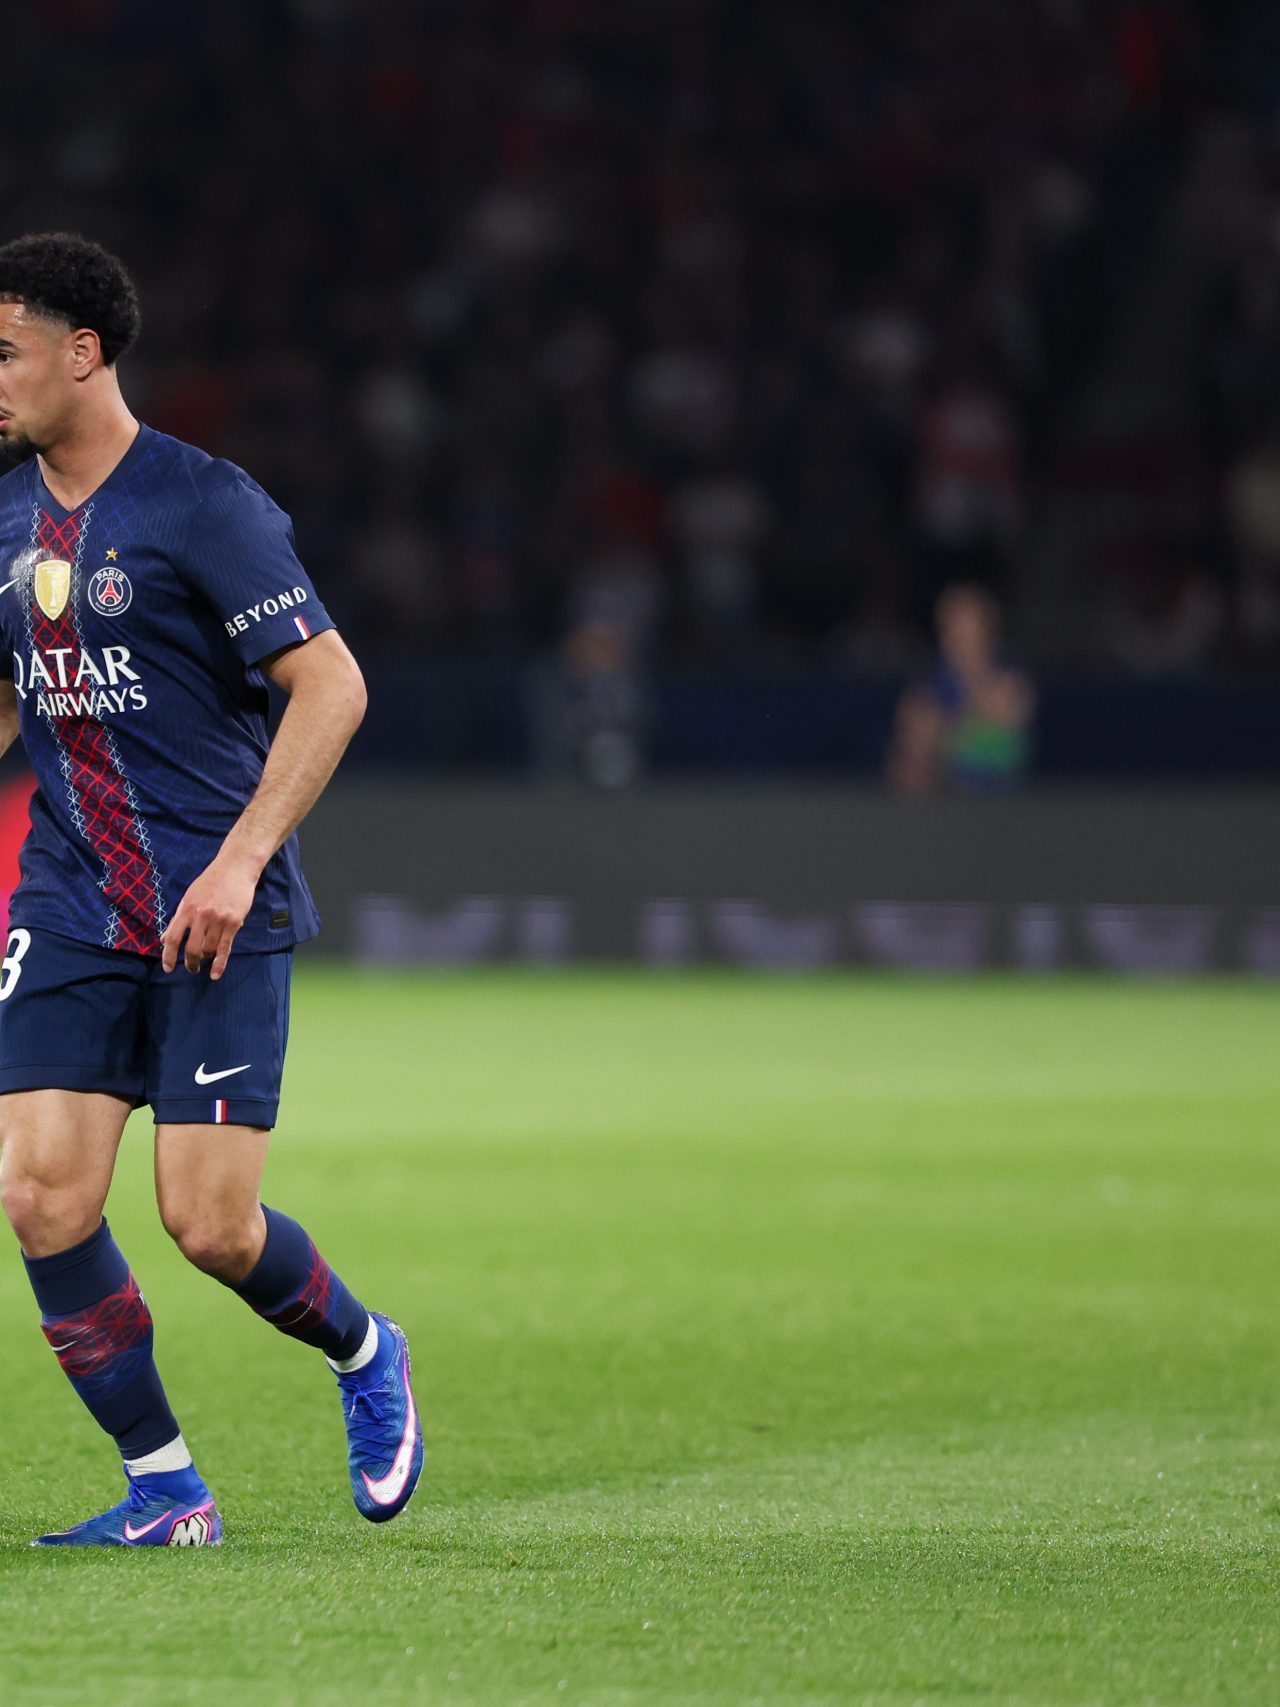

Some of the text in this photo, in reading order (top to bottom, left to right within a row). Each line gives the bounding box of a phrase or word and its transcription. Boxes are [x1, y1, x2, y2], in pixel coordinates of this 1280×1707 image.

[96, 569, 125, 582] PARIS
[224, 586, 307, 638] BEYOND
[36, 684, 148, 717] AIRWAYS
